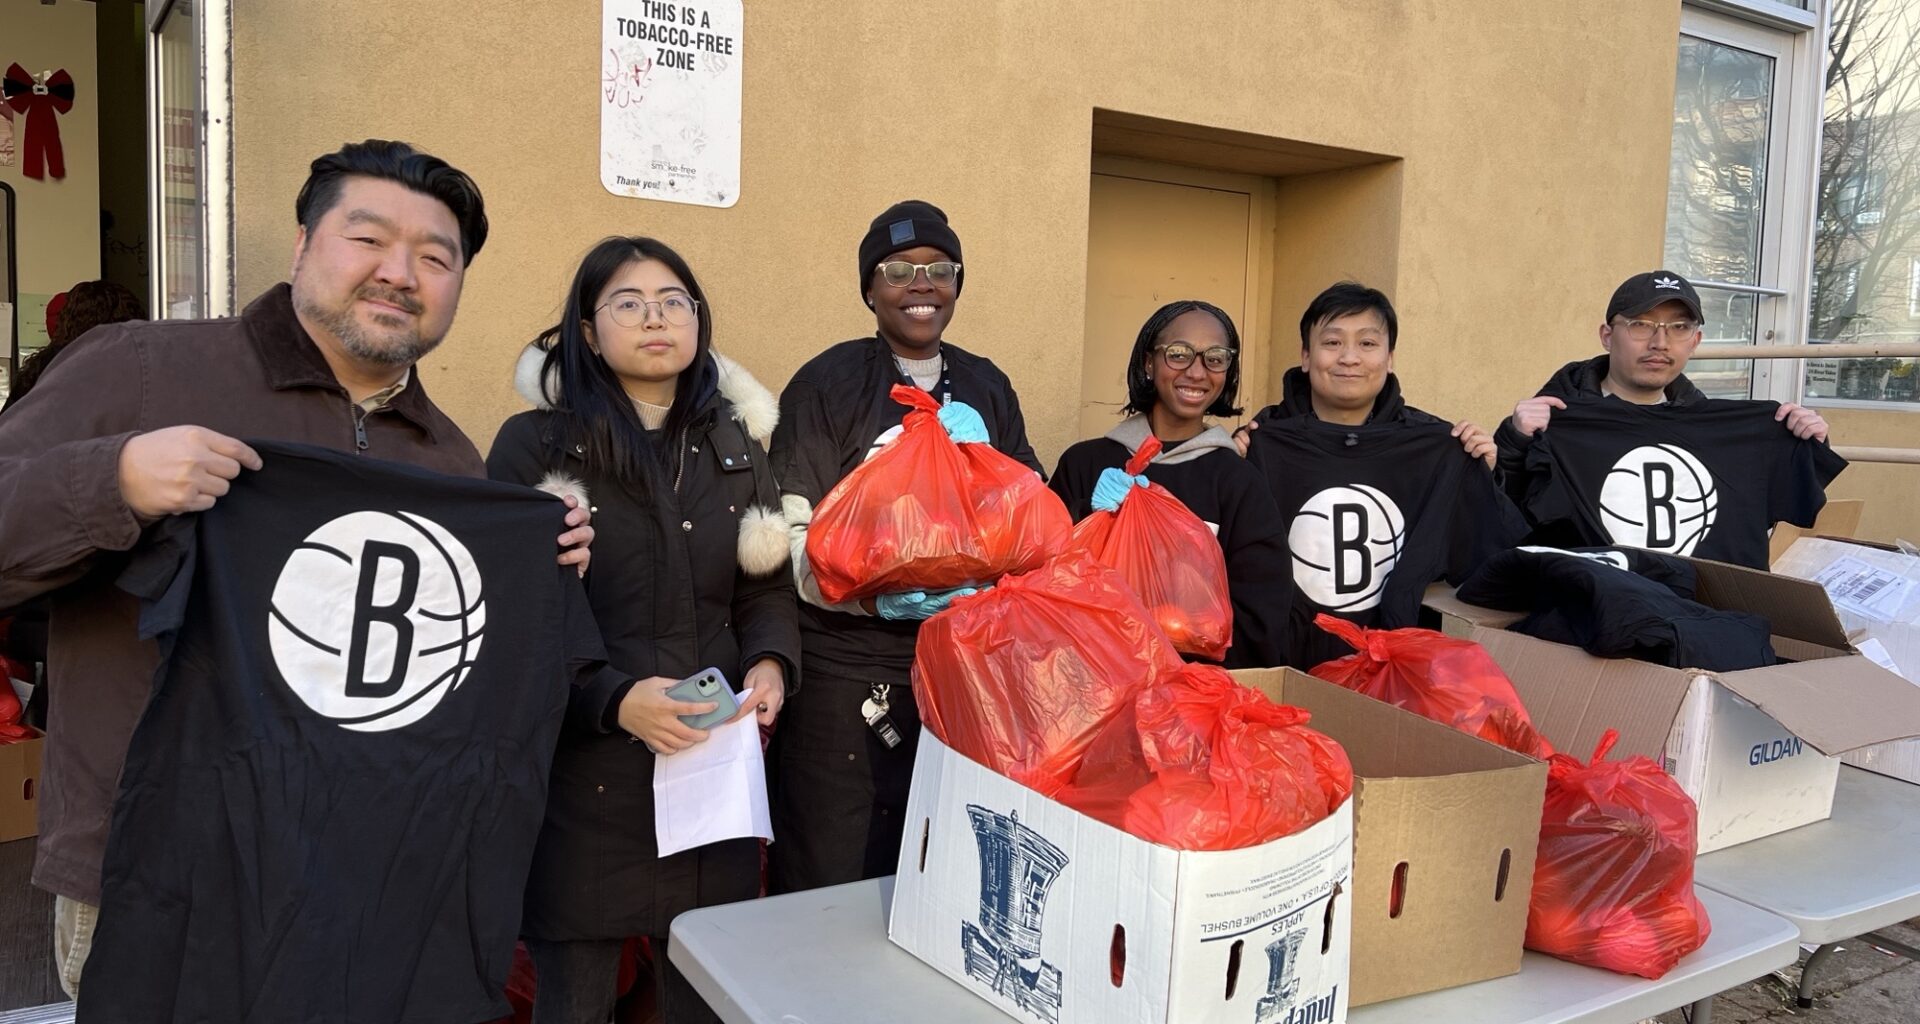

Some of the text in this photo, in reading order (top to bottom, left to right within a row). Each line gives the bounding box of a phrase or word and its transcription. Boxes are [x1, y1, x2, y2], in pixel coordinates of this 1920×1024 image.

[642, 0, 710, 29] THIS IS A
[617, 18, 733, 56] TOBACCO-FREE
[656, 48, 695, 71] ZONE
[616, 175, 661, 189] Thank you!
[651, 163, 697, 175] smke-free
[1643, 462, 1676, 549] B
[1332, 503, 1372, 595] B
[345, 539, 420, 698] B
[1749, 737, 1803, 766] GILDAN
[1243, 906, 1277, 926] VOLUME
[1277, 899, 1294, 914] ONE
[1201, 918, 1243, 933] BUSHEL
[1271, 910, 1305, 936] APPLES
